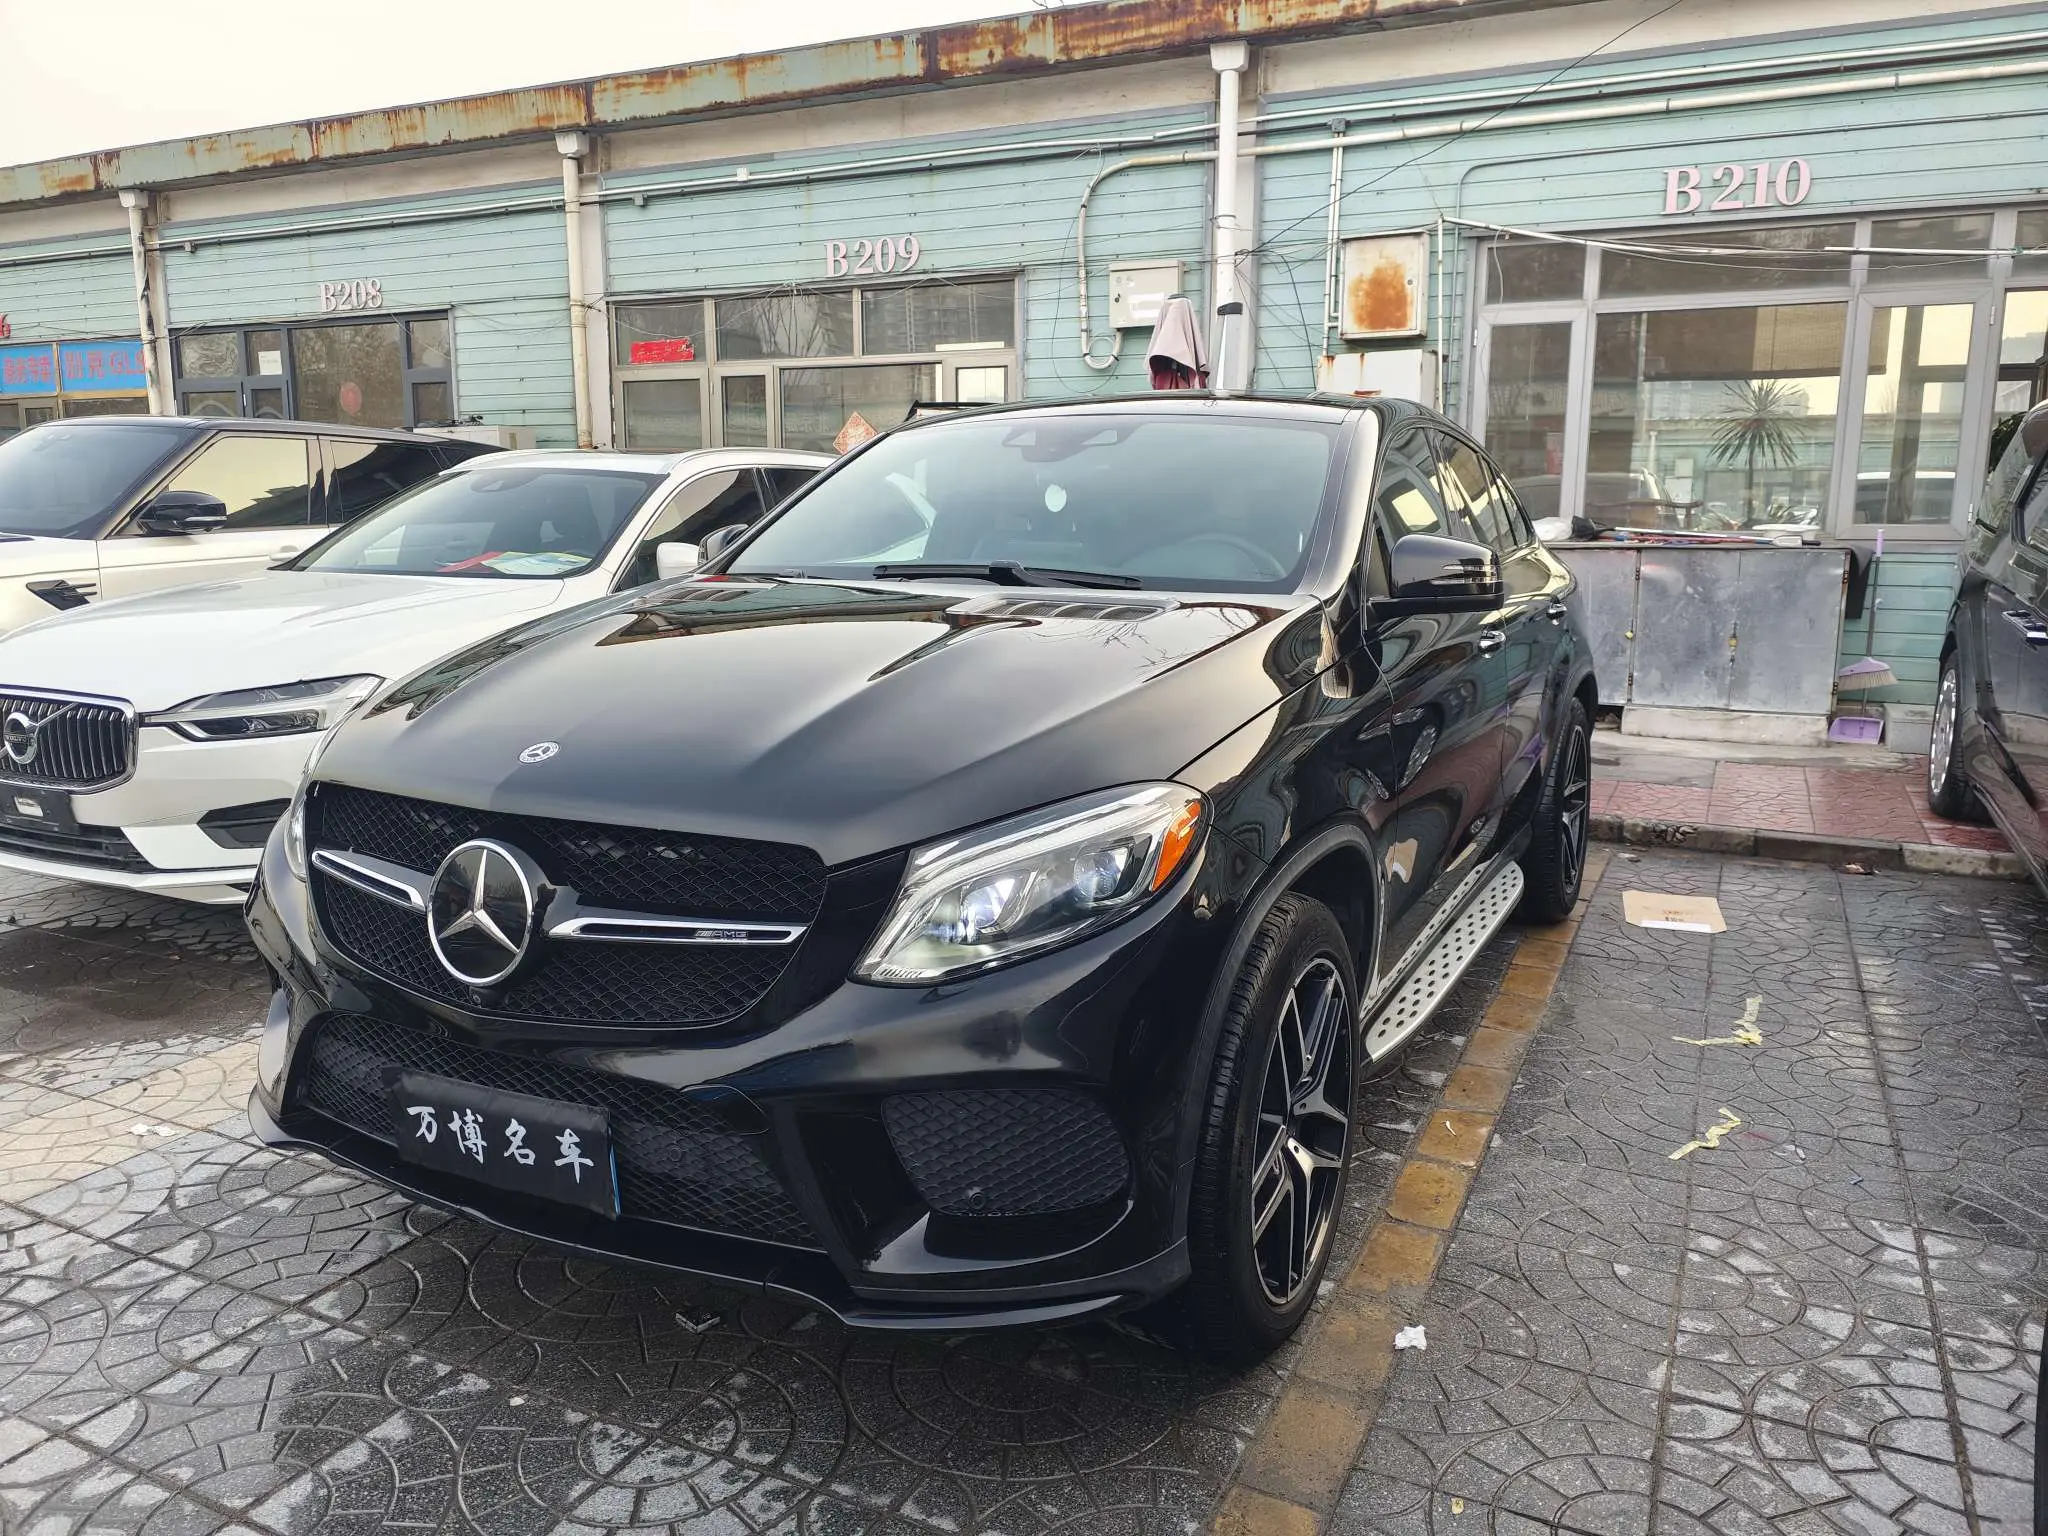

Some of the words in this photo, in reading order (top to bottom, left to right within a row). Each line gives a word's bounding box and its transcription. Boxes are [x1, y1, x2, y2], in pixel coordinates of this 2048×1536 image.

[1660, 158, 1811, 216] B210
[823, 235, 921, 278] B209
[320, 278, 384, 313] B208
[406, 1105, 595, 1184] 万博名车
